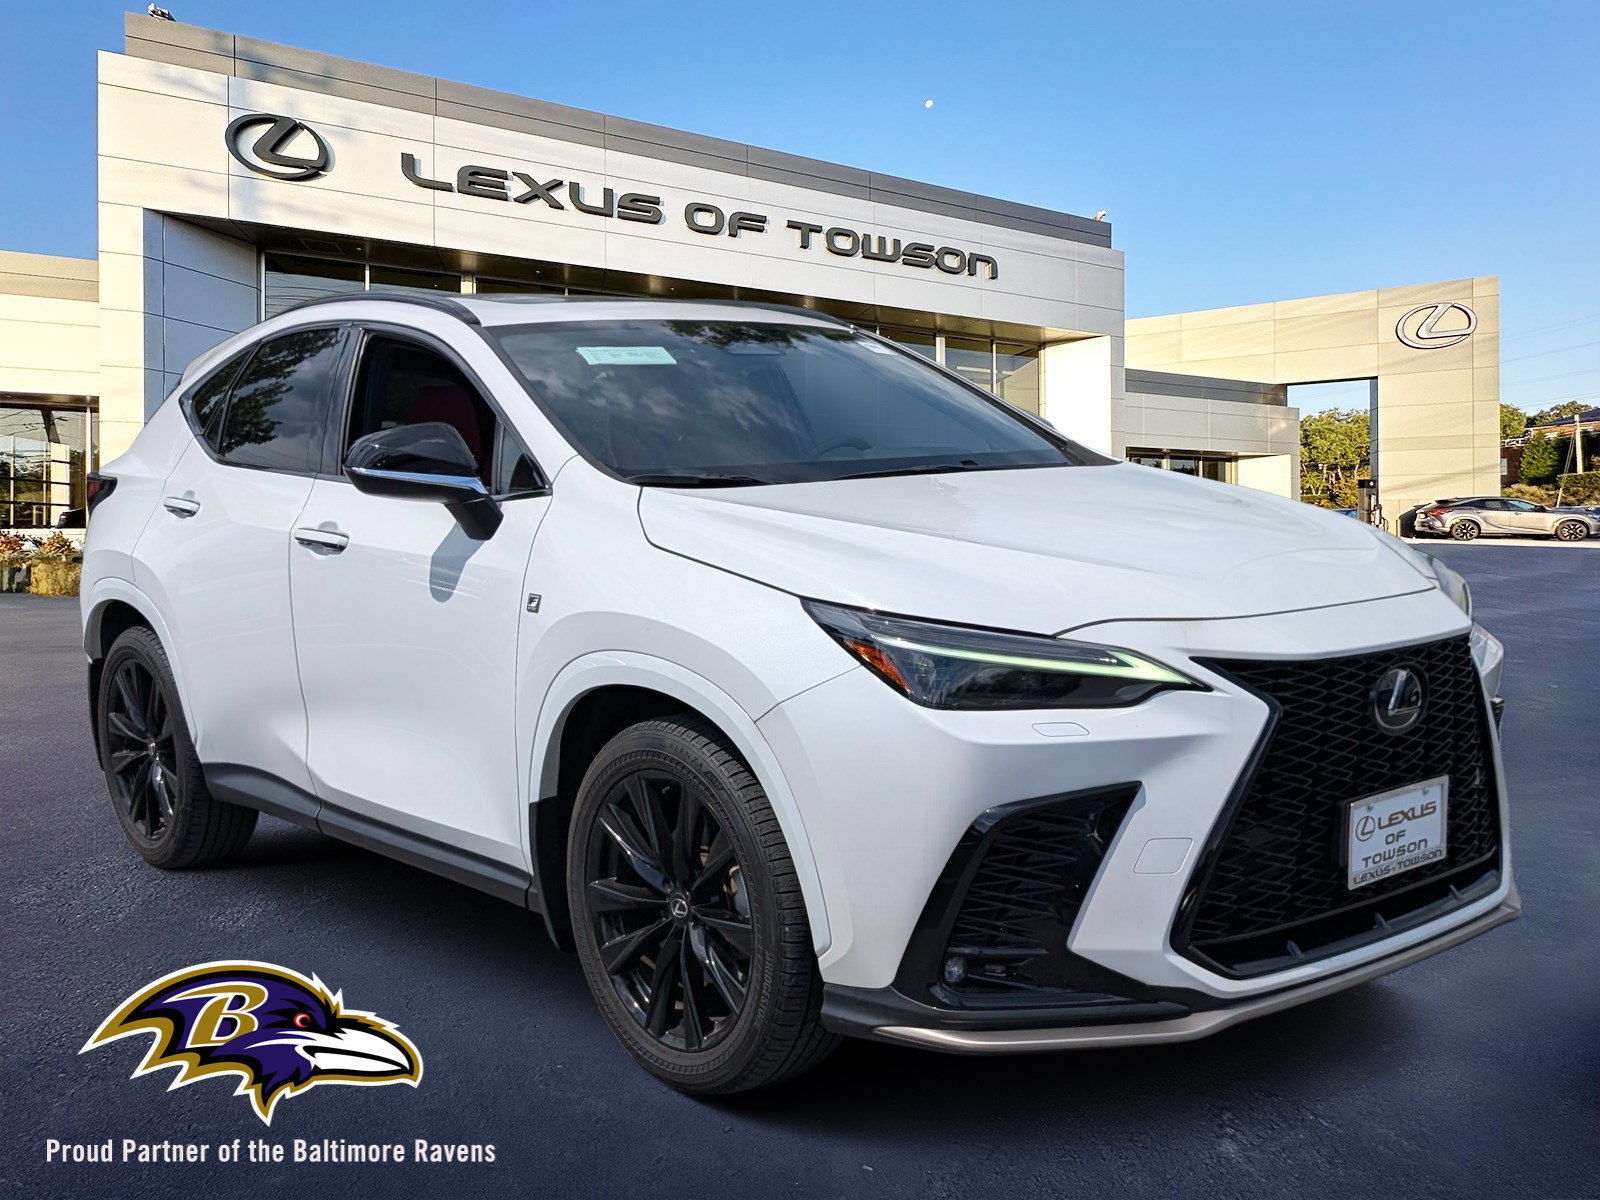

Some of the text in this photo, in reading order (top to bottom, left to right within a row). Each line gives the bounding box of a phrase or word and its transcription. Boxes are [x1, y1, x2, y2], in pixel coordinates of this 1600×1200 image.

[401, 152, 999, 280] LEXUS OF TOWSON
[1378, 801, 1436, 830] LEXUS
[1385, 829, 1407, 845] OF
[1354, 865, 1390, 885] LEXUS
[1396, 849, 1442, 869] TOWSON
[1362, 838, 1428, 868] TOWSON
